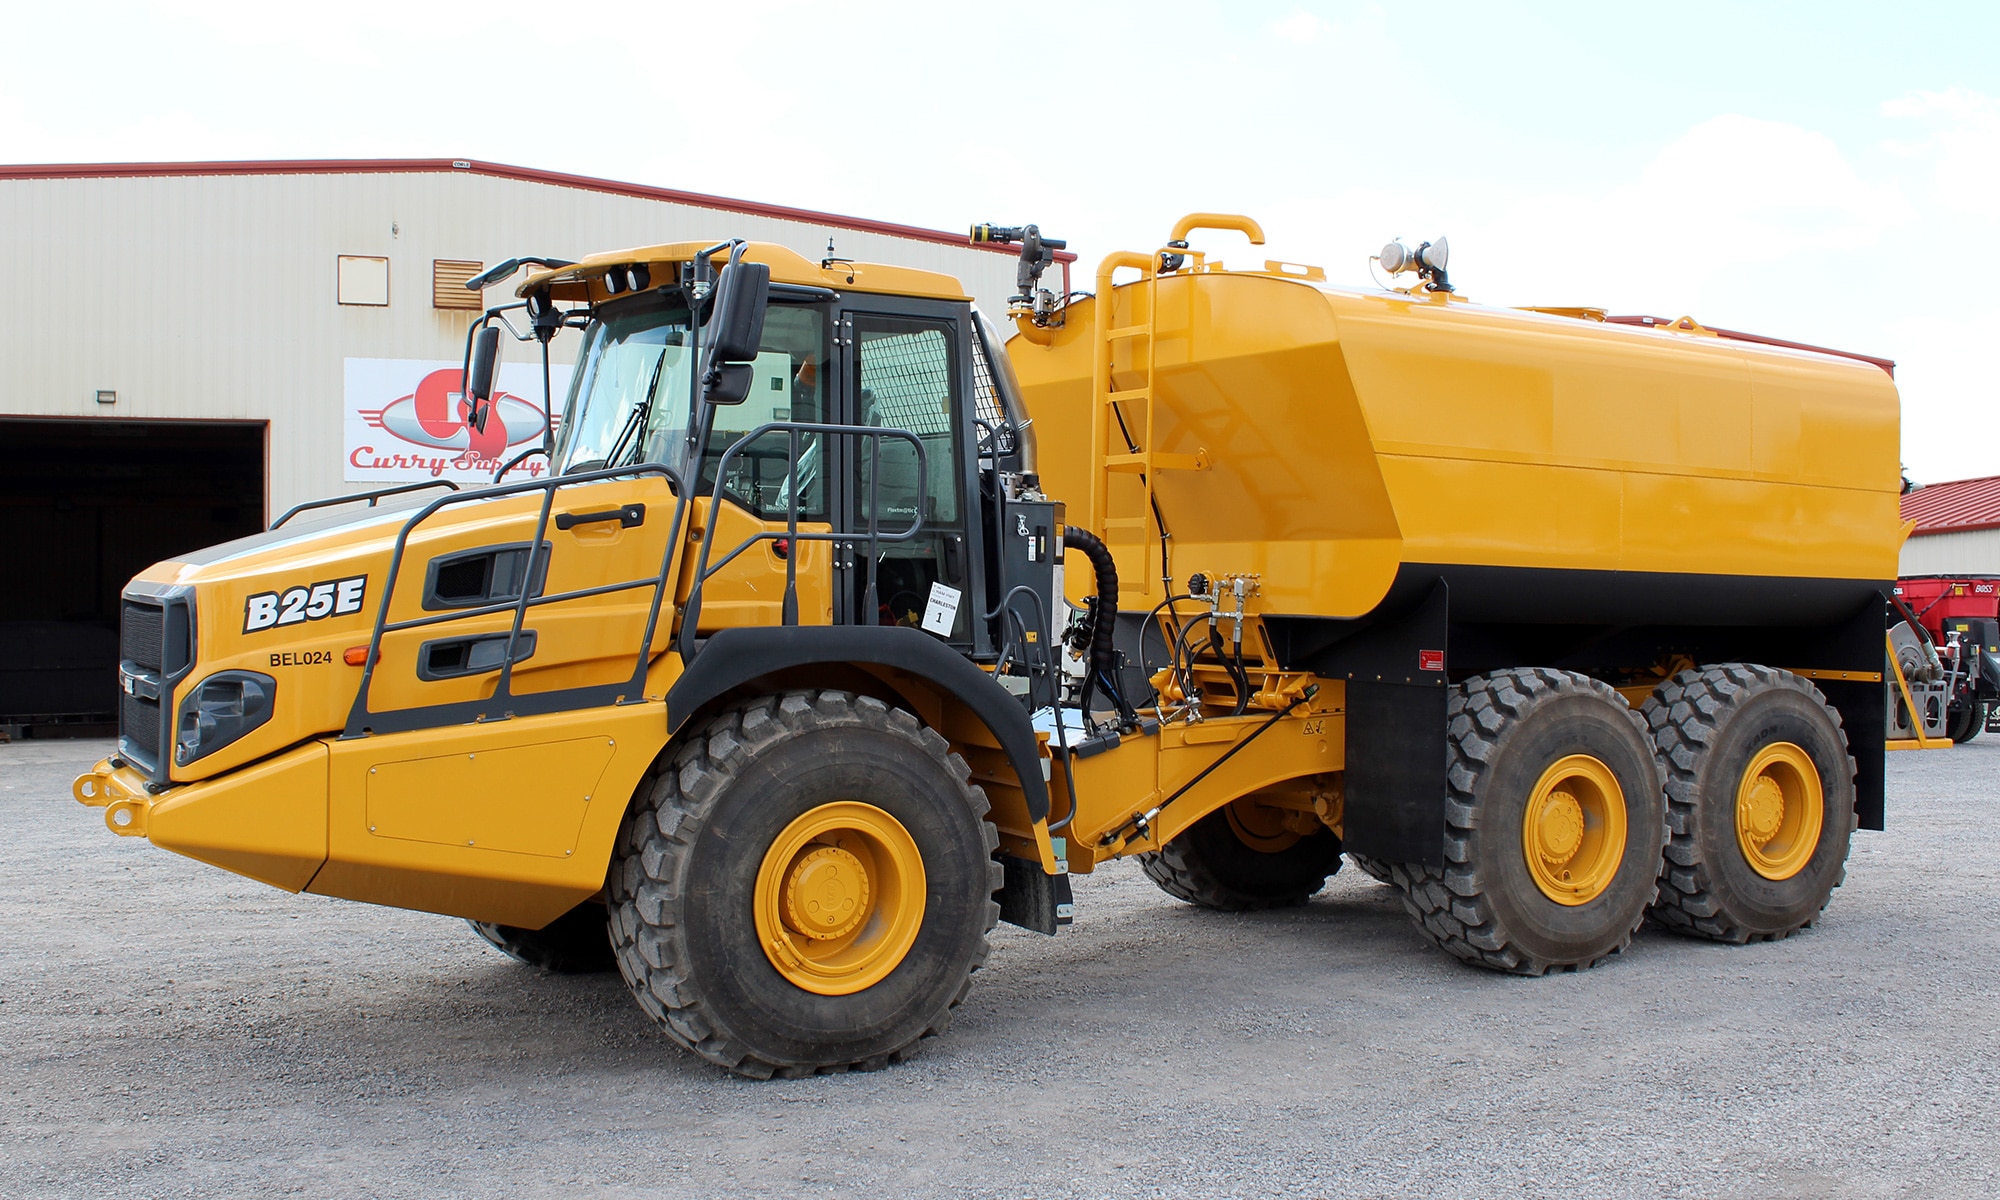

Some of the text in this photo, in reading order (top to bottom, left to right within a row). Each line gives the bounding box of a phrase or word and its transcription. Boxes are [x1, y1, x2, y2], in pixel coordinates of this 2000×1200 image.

[350, 446, 449, 477] Curry
[1975, 584, 1993, 594] BOSS
[243, 575, 367, 633] B25E
[930, 597, 956, 611] CHARLESTON
[935, 612, 942, 624] 1
[270, 651, 332, 667] BEL024
